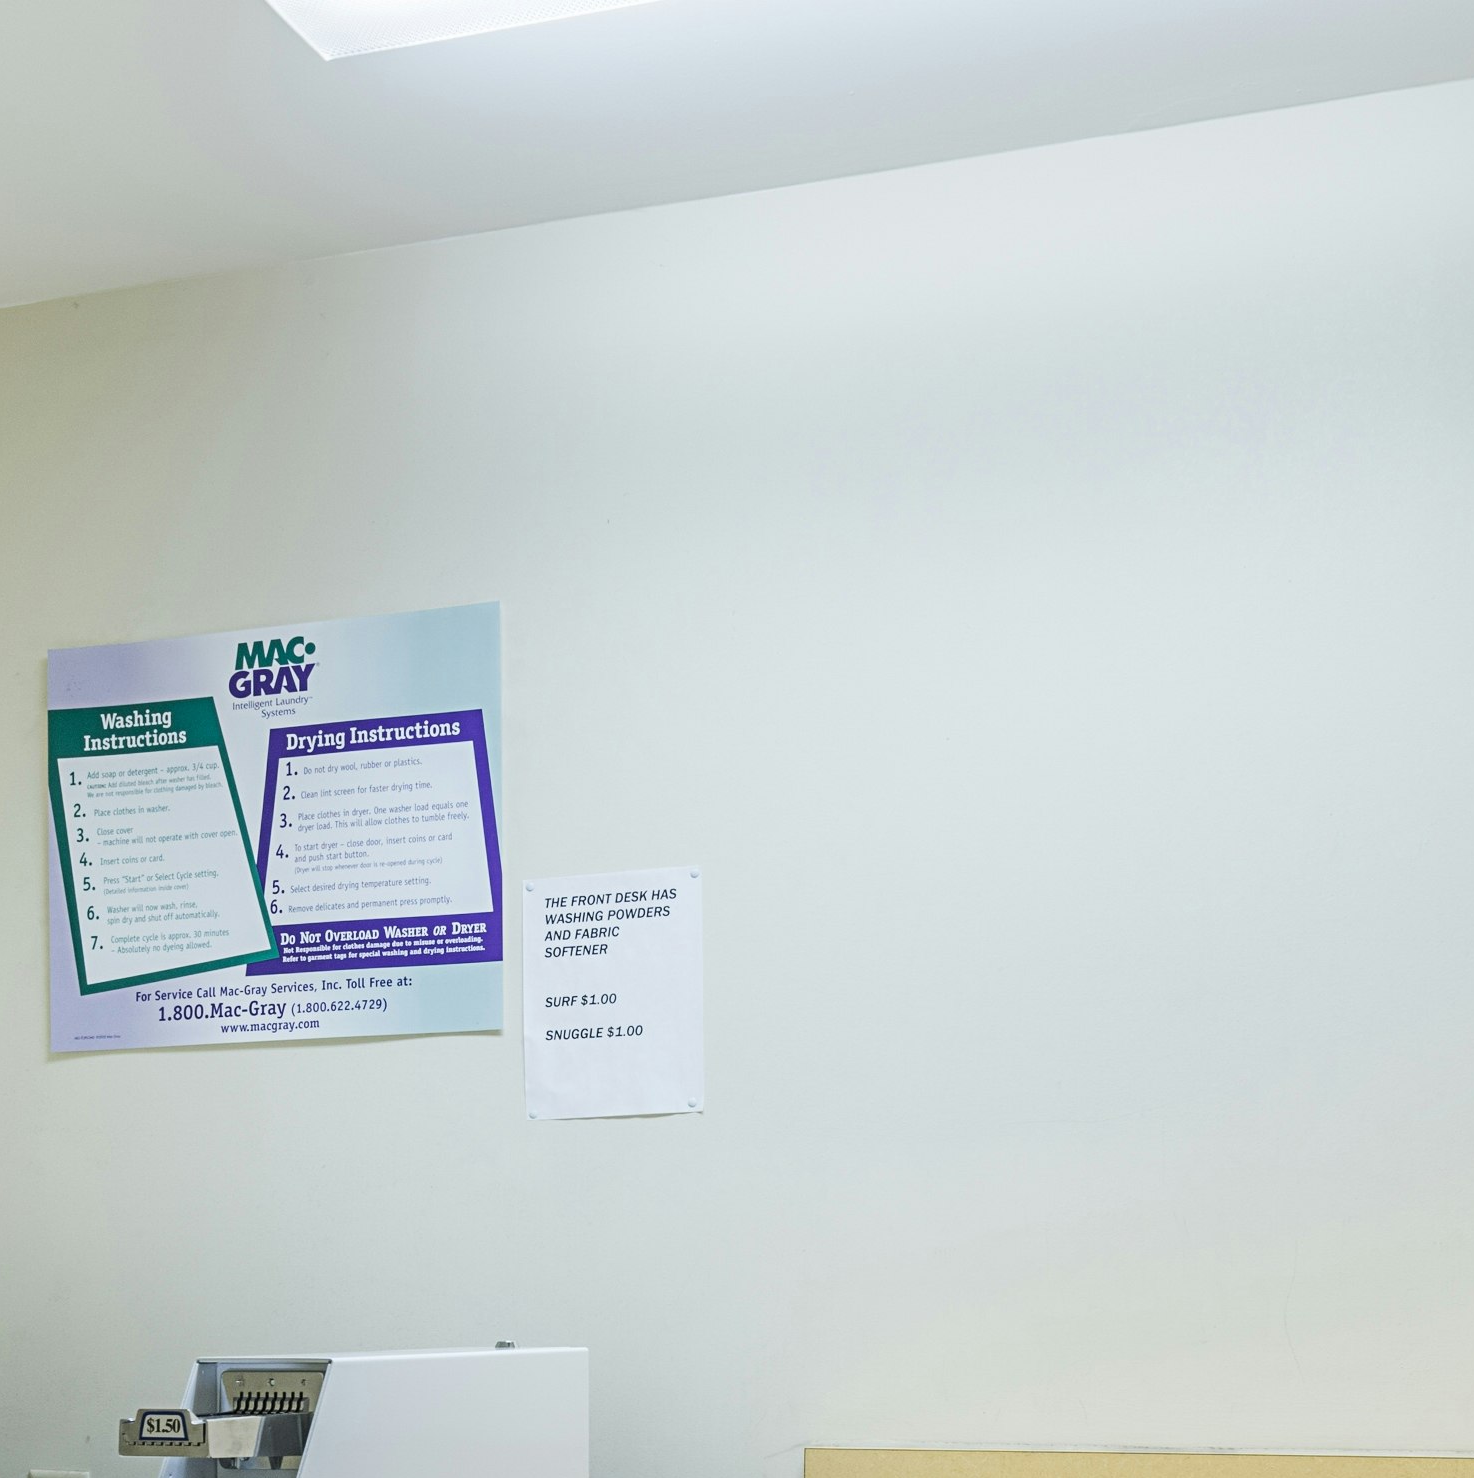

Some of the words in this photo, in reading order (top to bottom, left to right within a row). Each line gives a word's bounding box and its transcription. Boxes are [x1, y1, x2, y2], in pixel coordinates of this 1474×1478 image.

[100, 710, 171, 730] Washing
[261, 708, 295, 719] Systems
[83, 730, 186, 750] Instructions
[286, 730, 345, 752] Drying
[349, 721, 460, 742] Instructions
[286, 762, 298, 776] 1.
[303, 766, 312, 774] Do
[314, 765, 325, 773] not
[327, 764, 338, 773] dry
[360, 760, 381, 768] rubber
[283, 786, 295, 800] 2.
[300, 790, 318, 798] Clean
[357, 785, 366, 793] for
[369, 784, 389, 792] faster
[391, 782, 413, 792] drying
[73, 804, 86, 817] 2.
[93, 808, 110, 816] Place
[112, 807, 136, 815] clothes
[138, 805, 144, 813] in
[279, 814, 292, 828] 3.
[77, 828, 89, 842] 3.
[79, 852, 93, 866] 4.
[100, 857, 119, 865] Insert
[121, 856, 138, 864] coins
[276, 844, 289, 859] 4.
[272, 880, 285, 894] 5.
[290, 884, 310, 893] Select
[311, 882, 335, 891] desired
[337, 881, 358, 891] drying
[361, 879, 402, 887] temperature
[545, 896, 567, 907] THE
[571, 893, 611, 905] FRONT
[615, 890, 647, 902] DESK
[651, 888, 676, 899] HAS
[87, 906, 99, 920] 6.
[270, 899, 283, 914] 6.
[315, 902, 345, 910] delicates
[346, 900, 359, 908] and
[361, 899, 397, 909] permanent
[399, 898, 417, 906] press
[545, 910, 603, 924] WASHING
[607, 906, 669, 919] POWDERS
[544, 929, 570, 940] AND
[575, 926, 619, 938] FABRIC
[91, 936, 103, 950] 7.
[295, 944, 331, 953] Responsible
[342, 942, 364, 951] clothes
[365, 942, 390, 950] damage
[391, 940, 403, 949] due
[413, 939, 435, 947] misuse
[544, 944, 607, 957] SOFTENER
[307, 953, 332, 962] garment
[359, 950, 380, 958] special
[135, 991, 151, 1001] For
[155, 989, 192, 1000] Service
[196, 987, 215, 997] Call
[220, 985, 267, 996] Mac-Gray
[271, 982, 317, 993] Services,
[321, 980, 341, 990] Inc.
[345, 977, 365, 988] Toll
[369, 977, 392, 987] Free
[397, 976, 411, 986] at:
[545, 995, 577, 1007] SURF
[581, 993, 616, 1005] $1.00
[159, 1001, 286, 1020] 1.800.Mac-Gray
[291, 998, 387, 1015] (1.800.622.4729)
[220, 1020, 319, 1032] www.macgray.com
[545, 1027, 603, 1040] SNUGGLE
[607, 1025, 643, 1037] $1.00
[146, 1418, 180, 1434] $1.50
